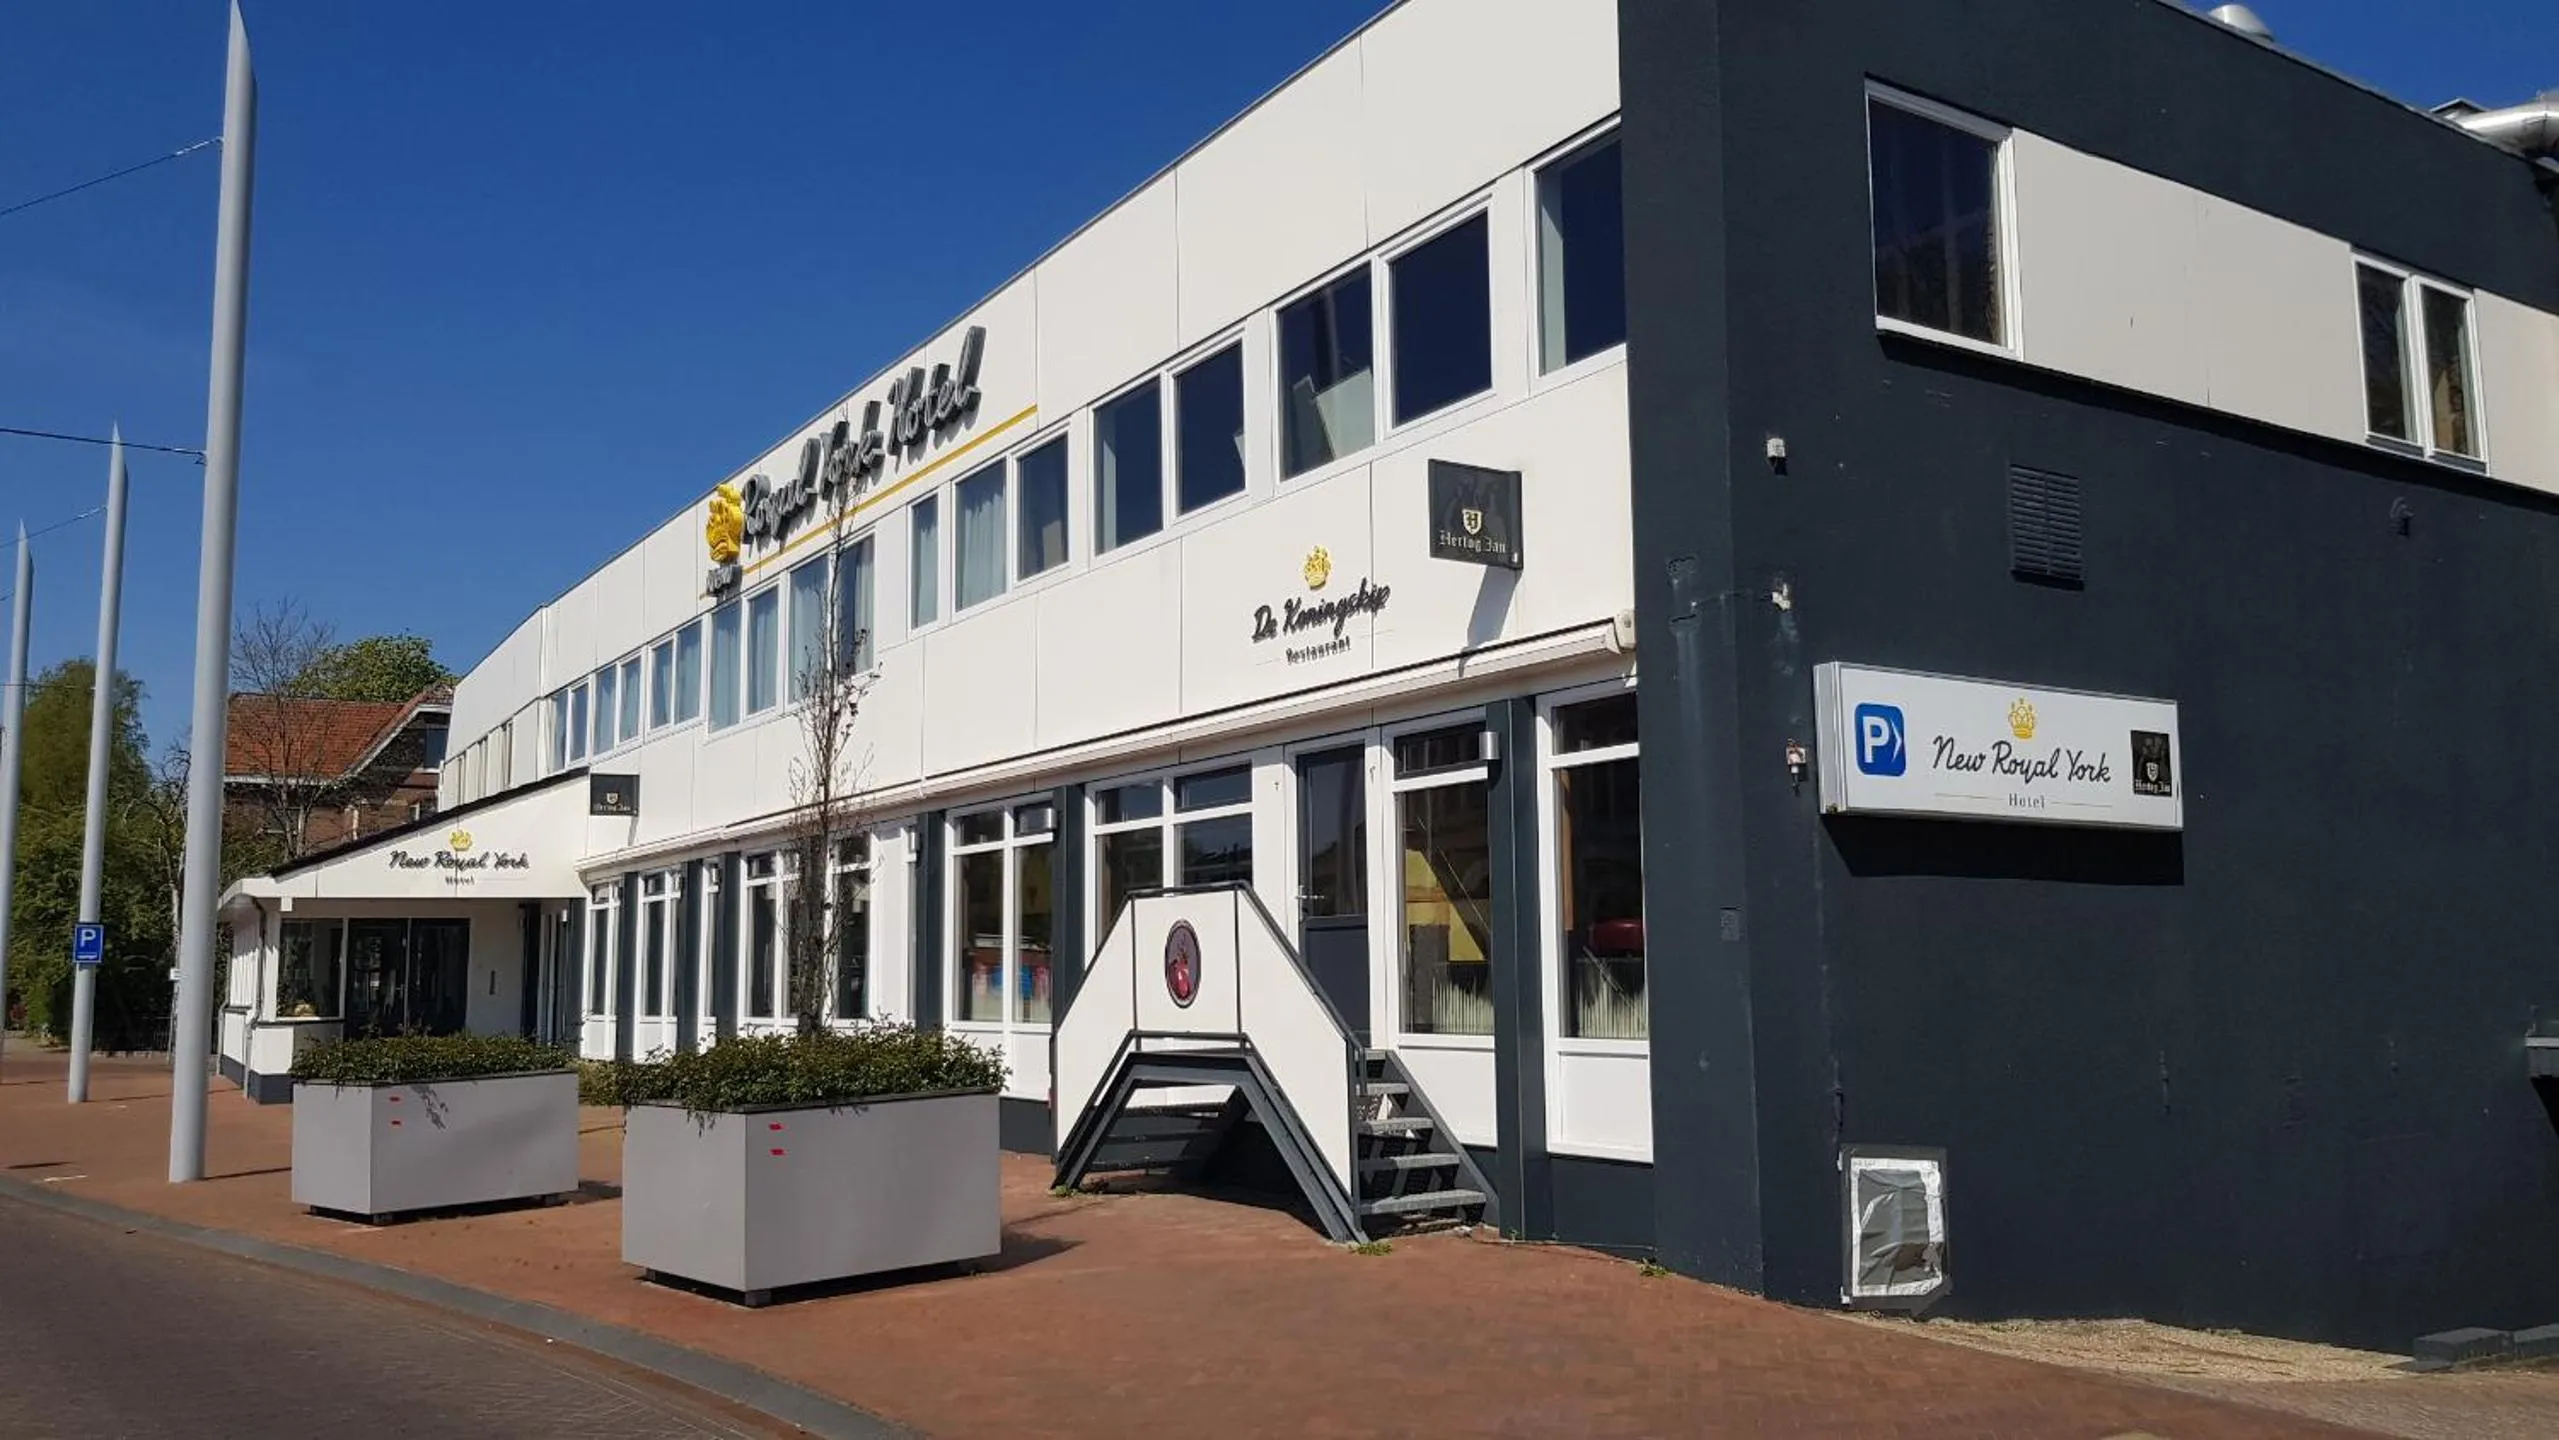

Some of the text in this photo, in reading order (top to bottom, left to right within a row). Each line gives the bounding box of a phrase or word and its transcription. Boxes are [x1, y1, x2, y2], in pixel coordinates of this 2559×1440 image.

[741, 325, 987, 544] Royal York Hotel
[1440, 529, 1506, 553] Hertog Jan
[1252, 604, 1278, 643] De
[1285, 635, 1351, 665] Restaurant
[1932, 734, 2112, 785] New Royal York
[2008, 792, 2046, 809] Hotel
[389, 850, 530, 872] New Royal York
[80, 928, 96, 948] P
